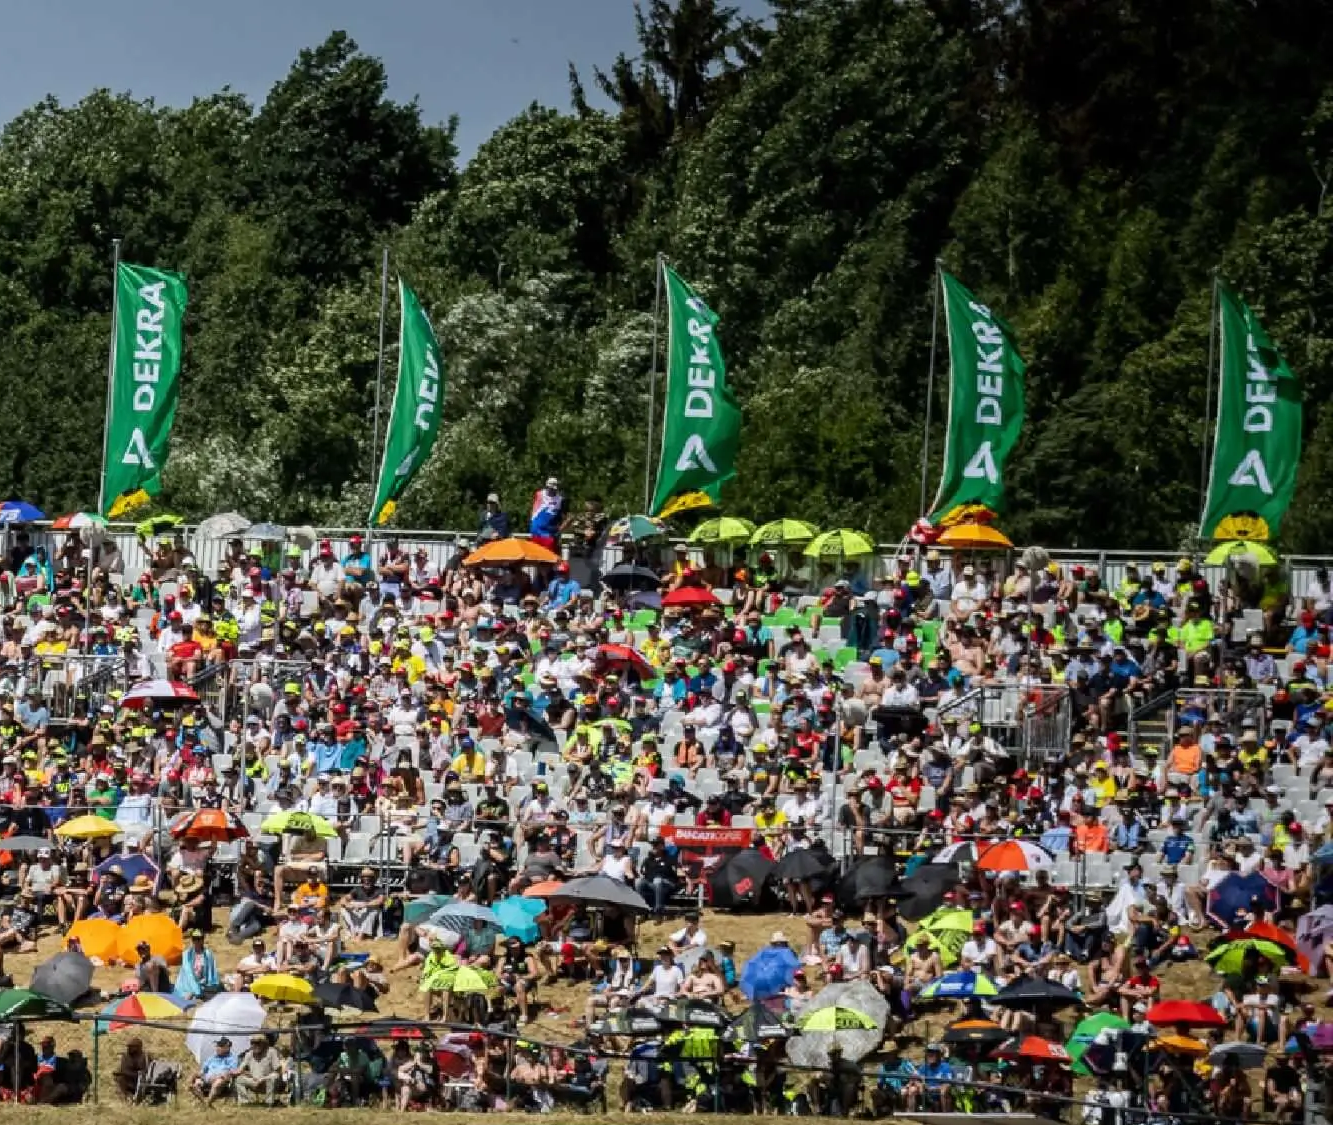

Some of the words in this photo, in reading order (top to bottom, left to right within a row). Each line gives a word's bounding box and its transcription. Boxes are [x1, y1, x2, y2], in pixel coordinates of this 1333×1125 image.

[132, 280, 167, 411] DEKRA
[414, 342, 440, 431] DEK
[1243, 333, 1277, 433] DEK
